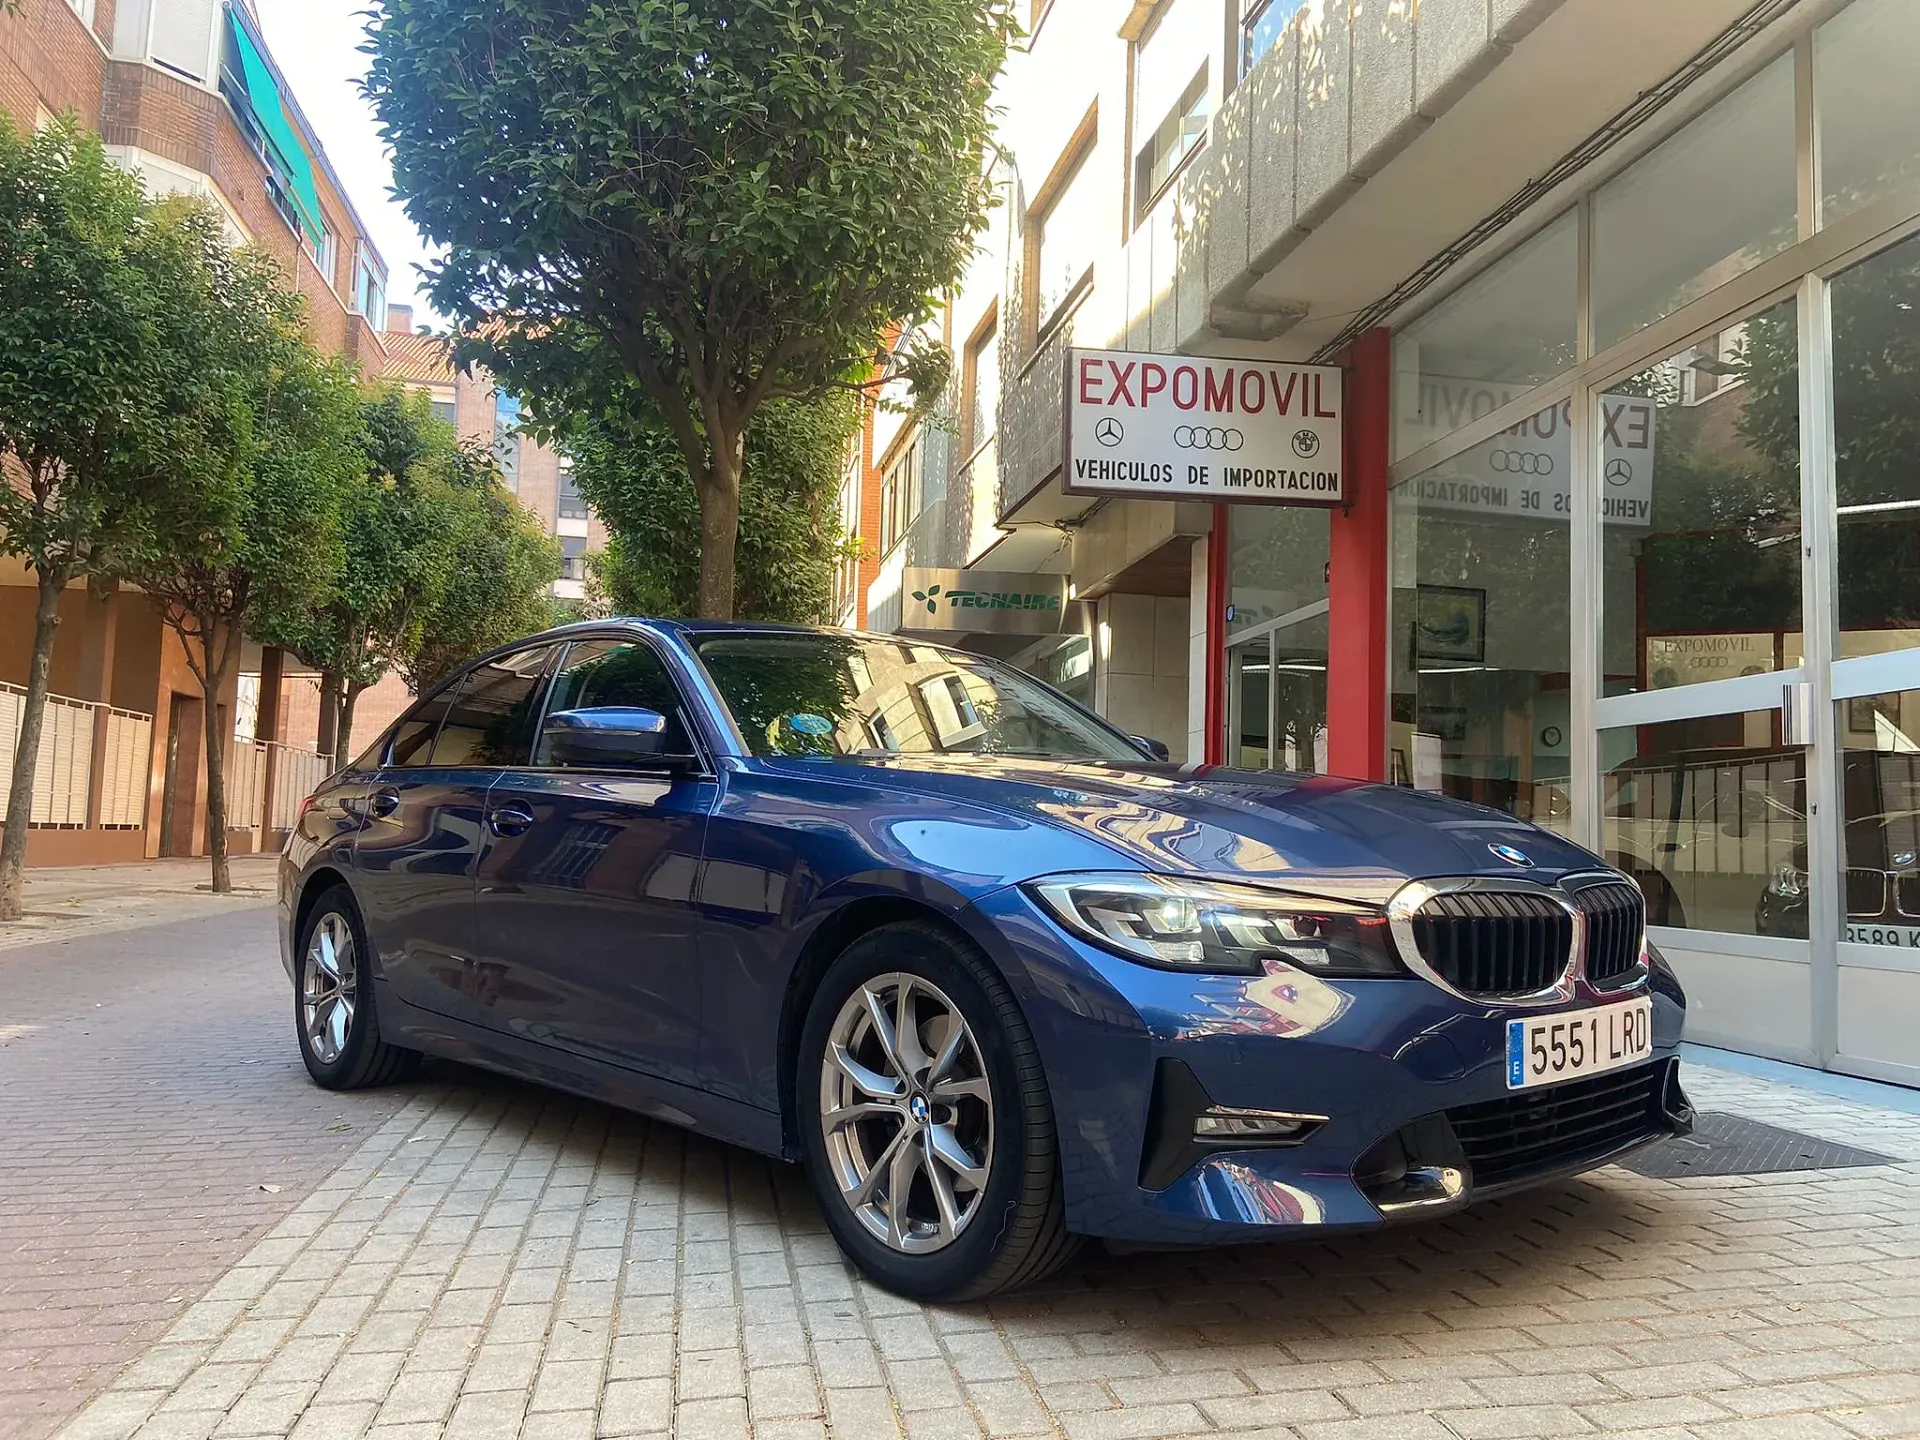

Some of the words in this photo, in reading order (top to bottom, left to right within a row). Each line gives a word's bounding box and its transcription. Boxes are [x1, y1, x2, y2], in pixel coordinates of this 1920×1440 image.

[1080, 358, 1336, 419] EXPOMOVIL
[1075, 458, 1173, 483] VEHICULOS
[1188, 466, 1209, 485] DE
[1224, 467, 1338, 492] IMPORTACION
[944, 590, 1061, 611] TECNAIRE
[1664, 637, 1755, 653] EXPOMOVIL
[1530, 1018, 1598, 1075] 5551
[1609, 1008, 1647, 1060] LRD
[1513, 1061, 1520, 1075] E
